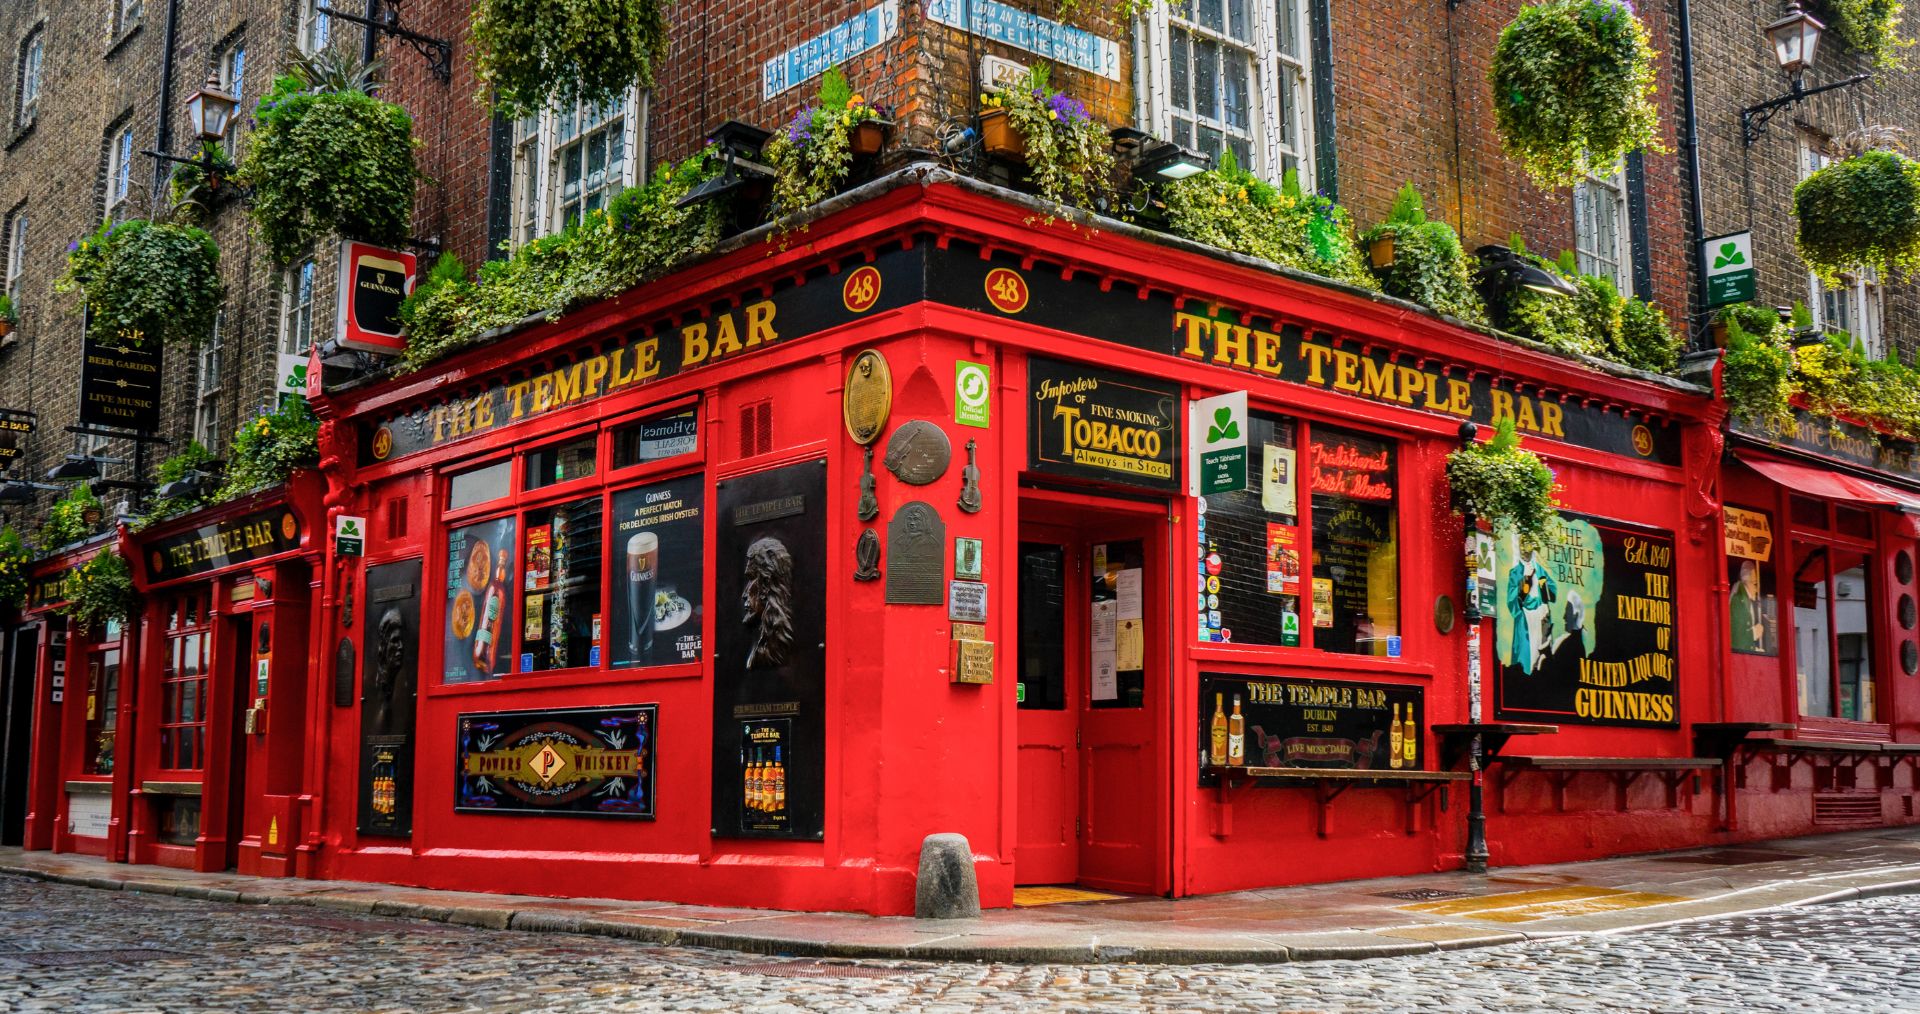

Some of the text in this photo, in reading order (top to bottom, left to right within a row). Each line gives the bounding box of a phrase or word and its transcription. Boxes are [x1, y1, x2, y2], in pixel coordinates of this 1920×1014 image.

[801, 49, 840, 76] TEMPLE
[1054, 44, 1094, 66] SOUTH
[360, 281, 400, 295] GUINNESS
[849, 275, 874, 305] 48
[992, 273, 1020, 302] 48
[88, 355, 157, 373] BEER GARDEN
[431, 299, 779, 444] THE TEMPLE BAR
[1175, 311, 1565, 439] THE TEMPLE BAR
[88, 392, 152, 409] LIVE MUSIC
[1035, 376, 1098, 405] Importers
[1075, 394, 1086, 404] OF
[103, 405, 137, 418] DAILY
[960, 411, 985, 422] Member
[1091, 404, 1160, 427] FINE SMOKING
[10, 421, 30, 431] BAR
[1052, 404, 1161, 458] TOBACCO
[1635, 430, 1648, 449] 48
[1076, 449, 1169, 475] Always in Stock
[1311, 443, 1388, 471] Traditional
[1311, 466, 1346, 492] Irish
[645, 490, 671, 503] GUINNESS
[619, 507, 699, 531] FOR DELICIOUS IRISH OYSTERS
[634, 500, 682, 517] A PERFECT MATCH
[1328, 510, 1362, 530] TEMPLE
[170, 520, 274, 567] THE TEMPLE BAR
[1559, 528, 1582, 547] THE
[1731, 540, 1745, 555] Area
[1546, 544, 1595, 569] TEMPLE
[1650, 544, 1670, 569] 1840
[1558, 567, 1584, 587] BAR
[1645, 572, 1670, 599] THE
[1617, 594, 1671, 625] EMPEROR
[675, 640, 702, 651] TEMPLE
[1656, 626, 1671, 651] OF
[682, 649, 695, 659] BAR
[968, 655, 988, 663] TEMPLE
[1579, 652, 1673, 688] MALTED LIQUORS
[1247, 682, 1388, 711] THE TEMPLE BAR
[1575, 686, 1674, 724] GUINNESS
[1303, 709, 1337, 722] DUBLIN
[751, 732, 769, 740] TEMPLE
[1287, 743, 1353, 755] LIVE MUSIC DAILY
[479, 756, 522, 772] POWERS
[574, 753, 631, 772] WHISKEY
